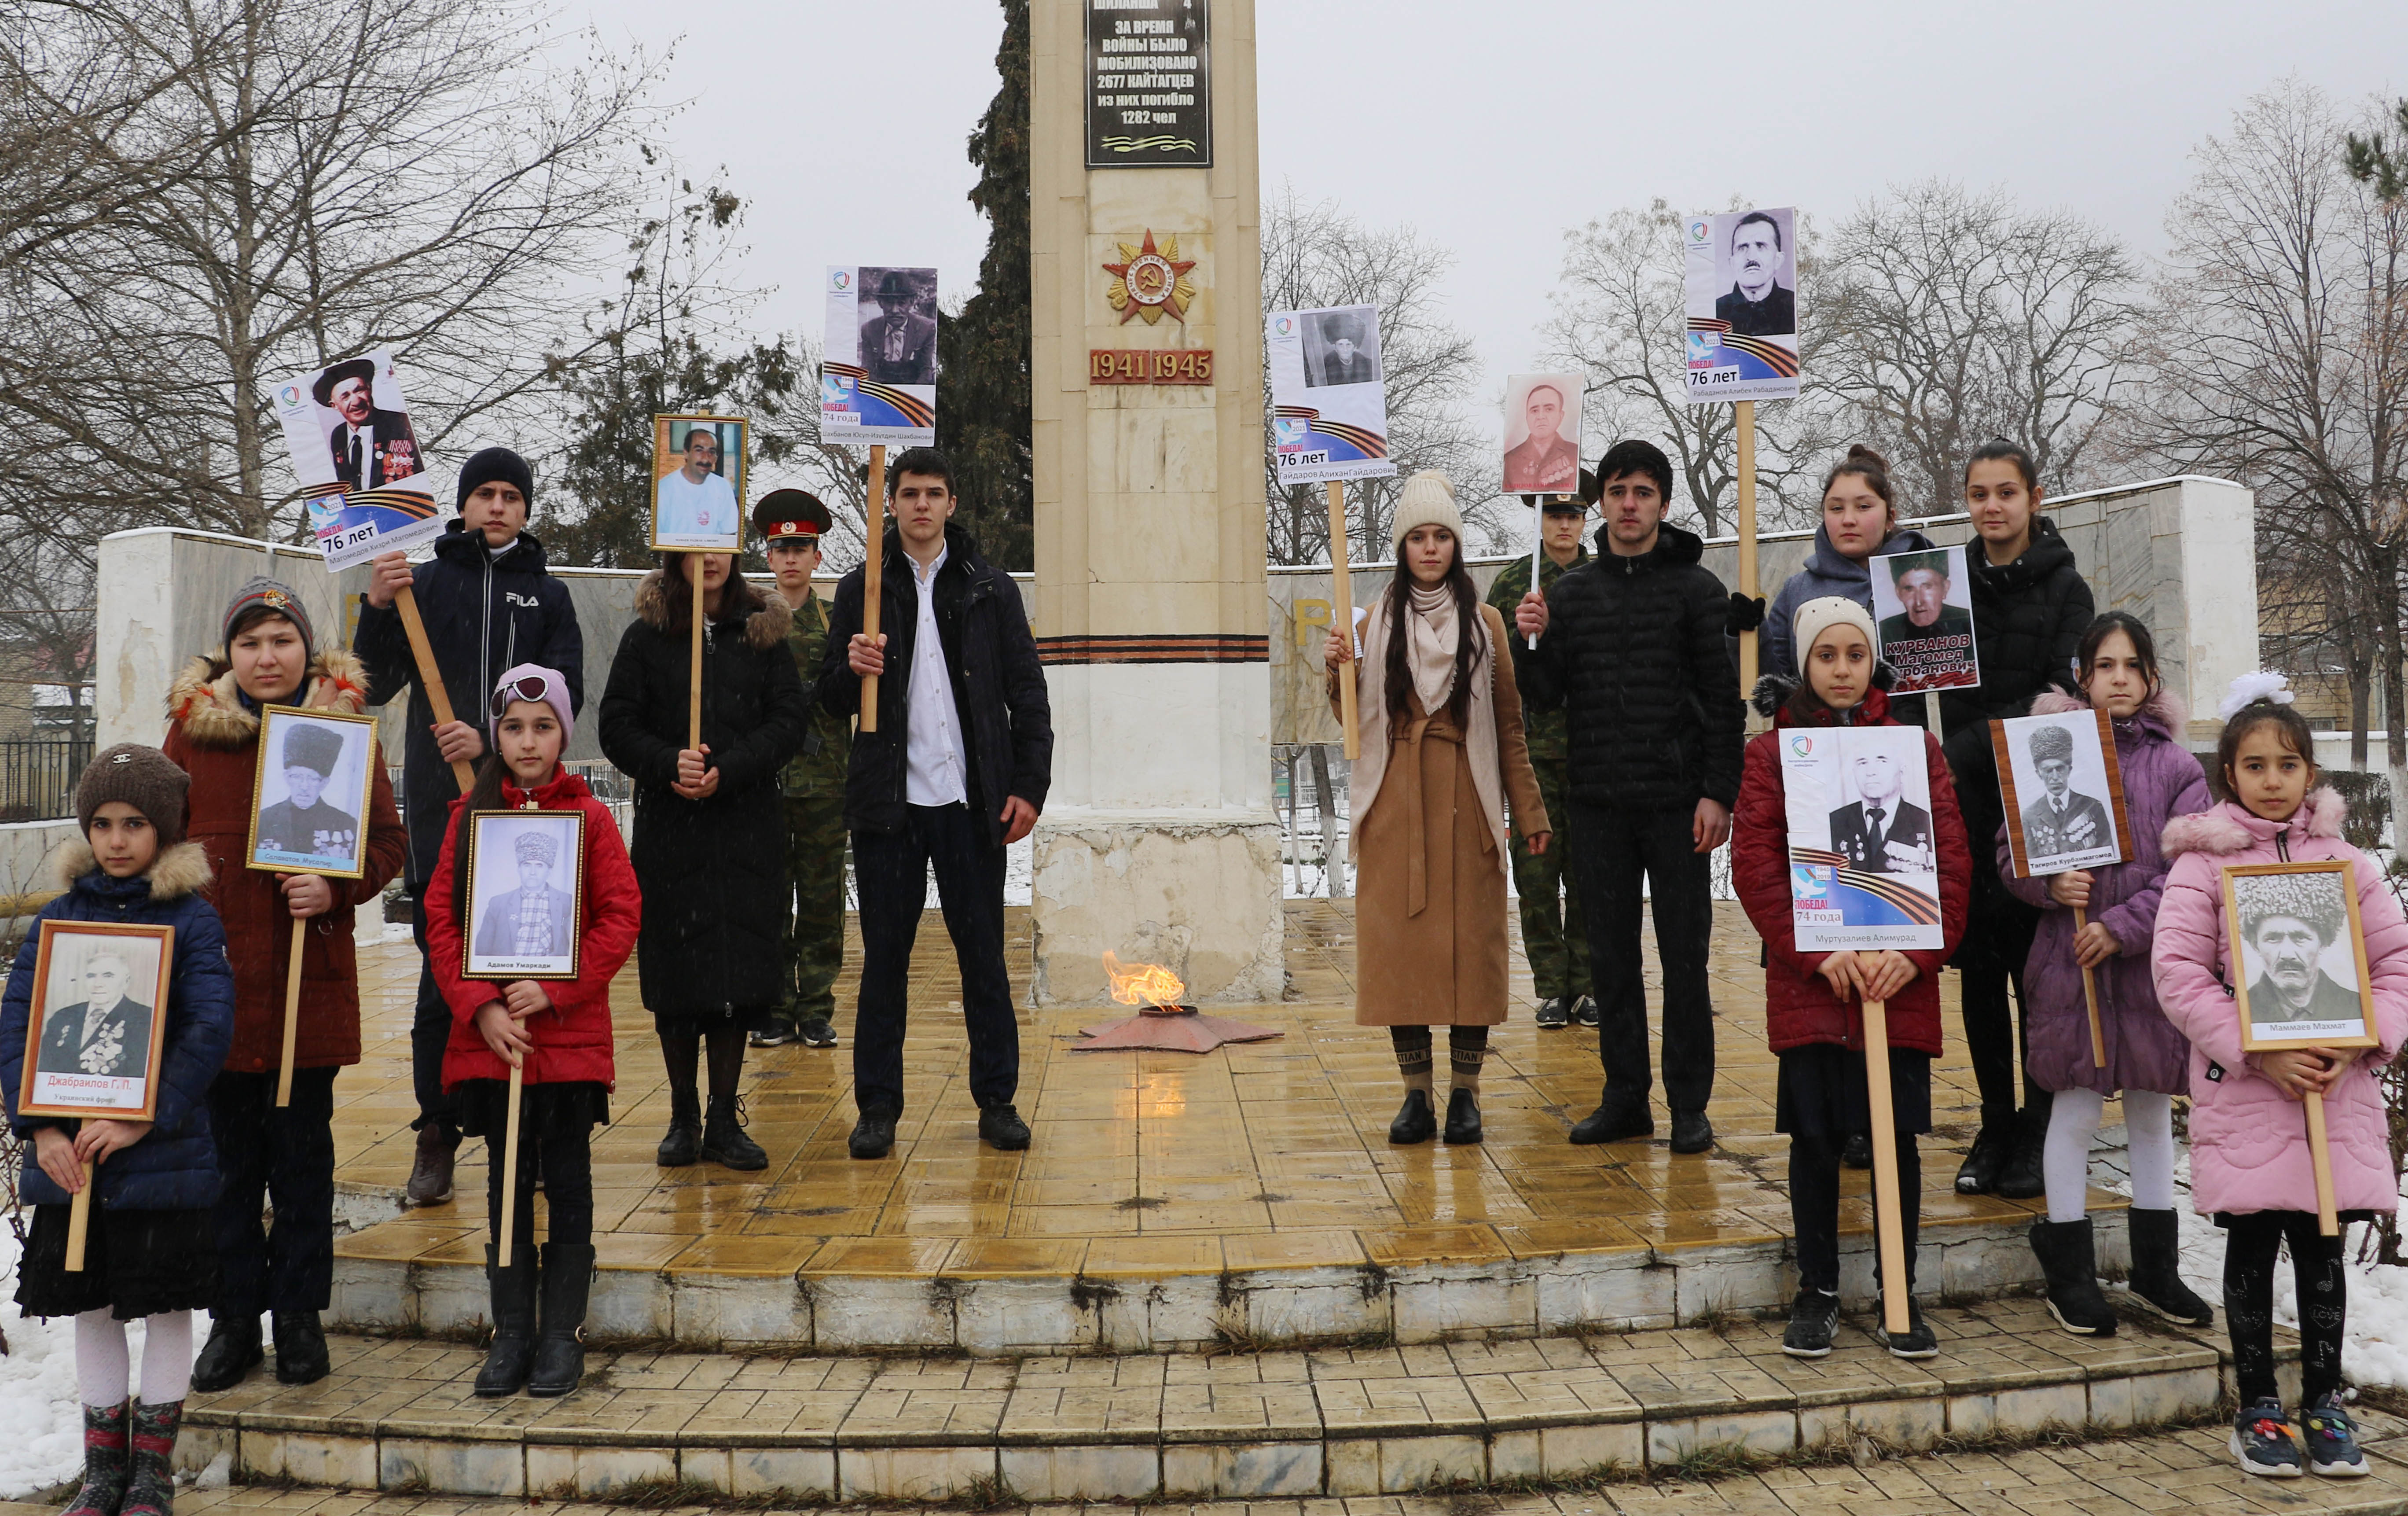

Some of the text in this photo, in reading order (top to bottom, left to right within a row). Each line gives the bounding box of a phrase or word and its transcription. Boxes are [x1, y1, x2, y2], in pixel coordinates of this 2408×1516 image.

[1115, 20, 1174, 34] ЗА ВРЕМЯ
[1102, 36, 1187, 52] ВОЙНЫ БЫЛО
[1097, 56, 1197, 70] МОБИЛИЗОВАНО
[1097, 72, 1194, 89] 2677 КАЙТАГЦЕВ
[1121, 110, 1176, 124] 1282 чел
[1091, 353, 1210, 378] 1941 1945
[1688, 360, 1713, 369] ПОБЕДА!
[1691, 372, 1736, 385] 76 лет
[823, 403, 848, 412] ПОБЕДА!
[1278, 444, 1303, 453] ПОБЕДА!
[1279, 453, 1325, 466] 76 лет
[1279, 471, 1317, 480] Гайдаров
[1349, 467, 1395, 477] Гайдарович
[327, 501, 342, 511] 2021
[316, 524, 343, 539] ПОБЕДА!
[323, 526, 374, 553] 76 лет
[329, 523, 439, 565] Магомедов Хизри Магомедович
[506, 592, 539, 607] FILA
[1886, 634, 1970, 655] КУРБАНОВ
[1895, 649, 1964, 666] Магомед
[1900, 660, 1975, 679] рбанович
[2059, 852, 2112, 865] Курбанмагомед
[1795, 900, 1828, 909] ПОБЕДА!
[1796, 912, 1841, 922] 74 года
[1815, 934, 1916, 943] Муртузалиев Алимурад
[48, 1075, 132, 1090] Джабраилов Г. П.
